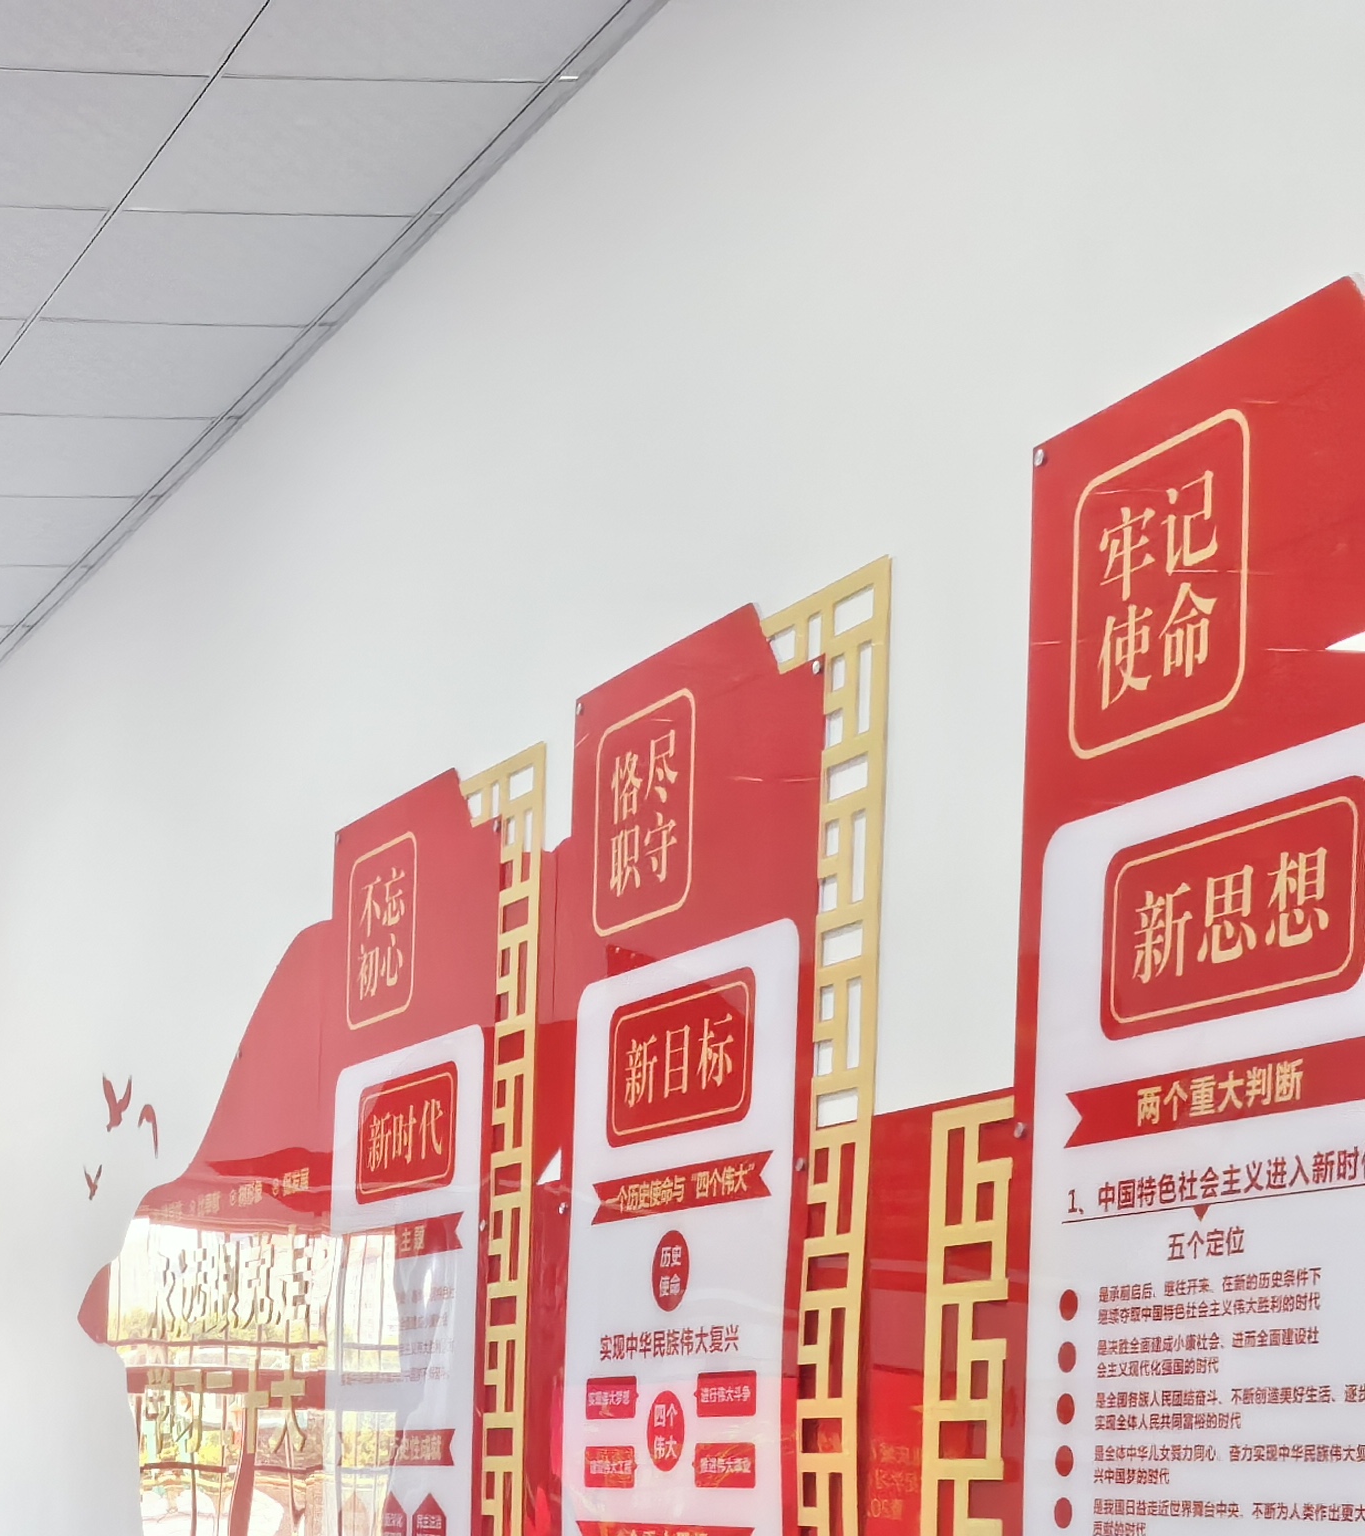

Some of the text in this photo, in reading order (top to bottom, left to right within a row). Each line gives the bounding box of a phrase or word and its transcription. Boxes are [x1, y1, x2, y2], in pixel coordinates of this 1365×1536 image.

[1098, 469, 1218, 601] 牢记
[1098, 581, 1216, 711] 使命
[611, 729, 678, 825] 恪尽
[609, 812, 677, 898] 职守
[359, 866, 405, 938] 不忘
[1133, 847, 1330, 984] 新思想
[357, 934, 403, 1001] 初心
[623, 1013, 734, 1109] 新目标
[1137, 1058, 1304, 1126] 两个重大判断
[367, 1100, 444, 1172] 新时代
[660, 1245, 682, 1267] 历史
[1167, 1226, 1244, 1261] 五个定位
[600, 1324, 739, 1360] 实现中华民族伟大复兴
[654, 1403, 677, 1428] 四个
[654, 1435, 677, 1460] 伟大
[1094, 1468, 1169, 1484] 兴中国梦的时代
